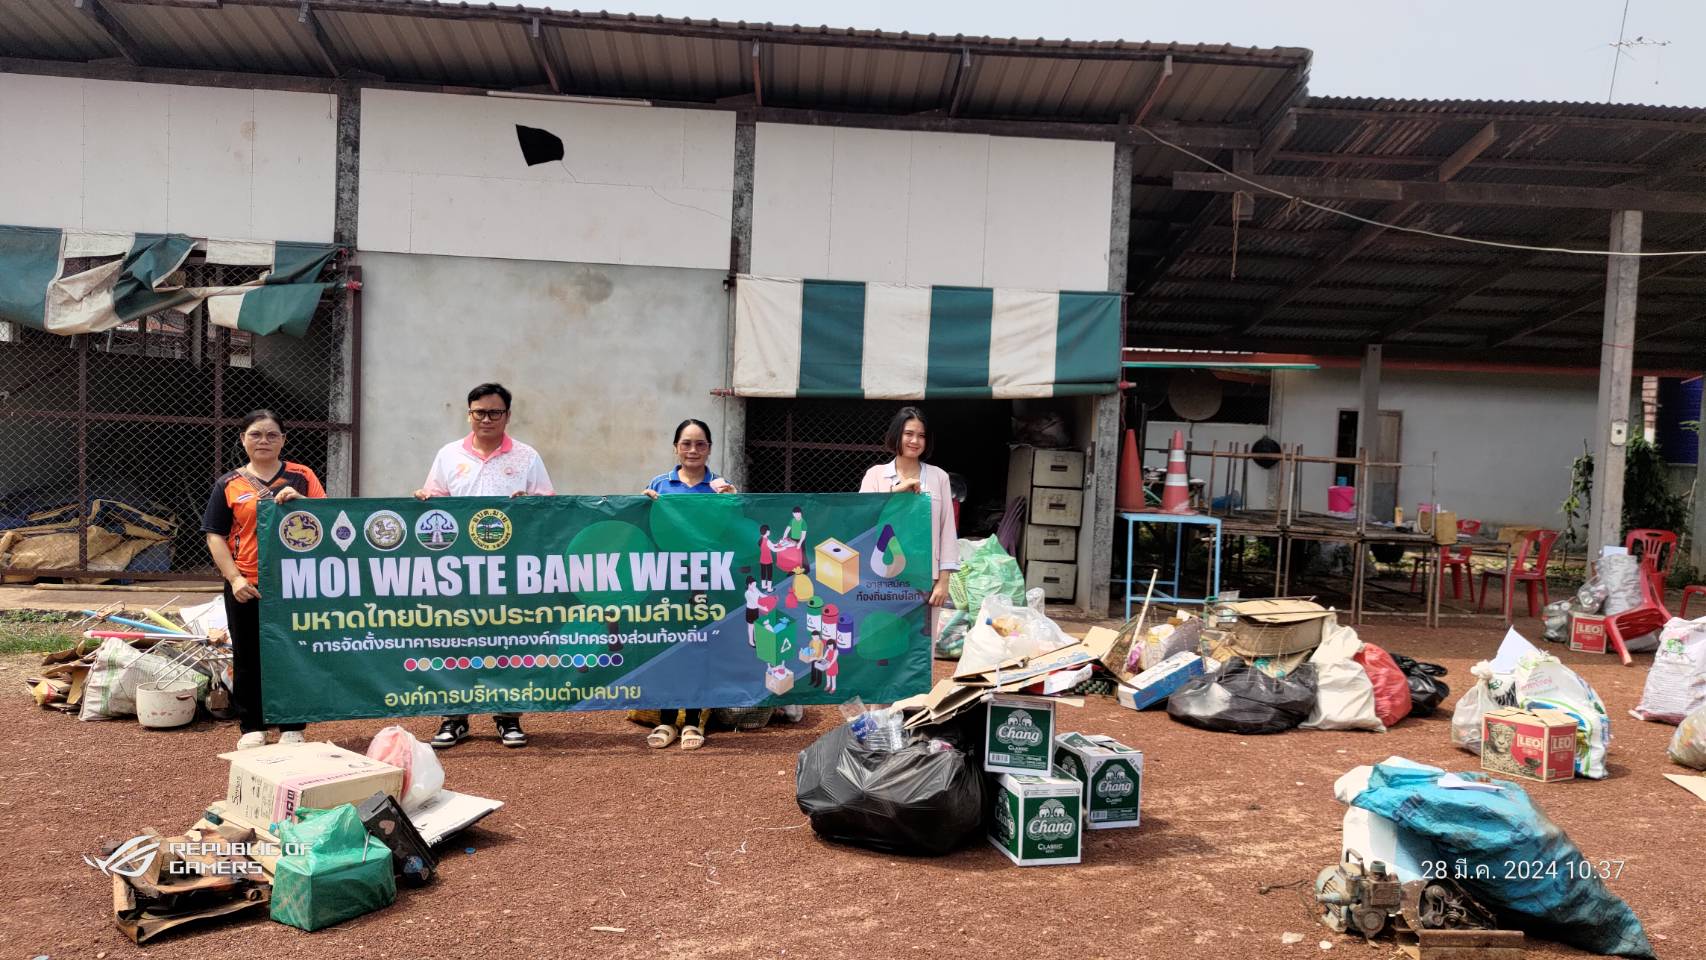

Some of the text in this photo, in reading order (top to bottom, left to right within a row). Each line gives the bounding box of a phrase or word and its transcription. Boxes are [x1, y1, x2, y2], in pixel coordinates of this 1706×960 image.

[281, 551, 736, 599] MOI WASTE BANK WEEK
[291, 594, 726, 631] มหาดไทยปักธงประกาศความสำเร็จ
[1578, 623, 1600, 634] LEO
[384, 681, 642, 707] องค์การบริหารส่วนตำบลมาย
[998, 725, 1040, 743] Chang
[1519, 735, 1541, 748] LEO
[1552, 737, 1571, 749] LEO
[1098, 780, 1132, 794] Chang
[1029, 819, 1073, 835] Chang
